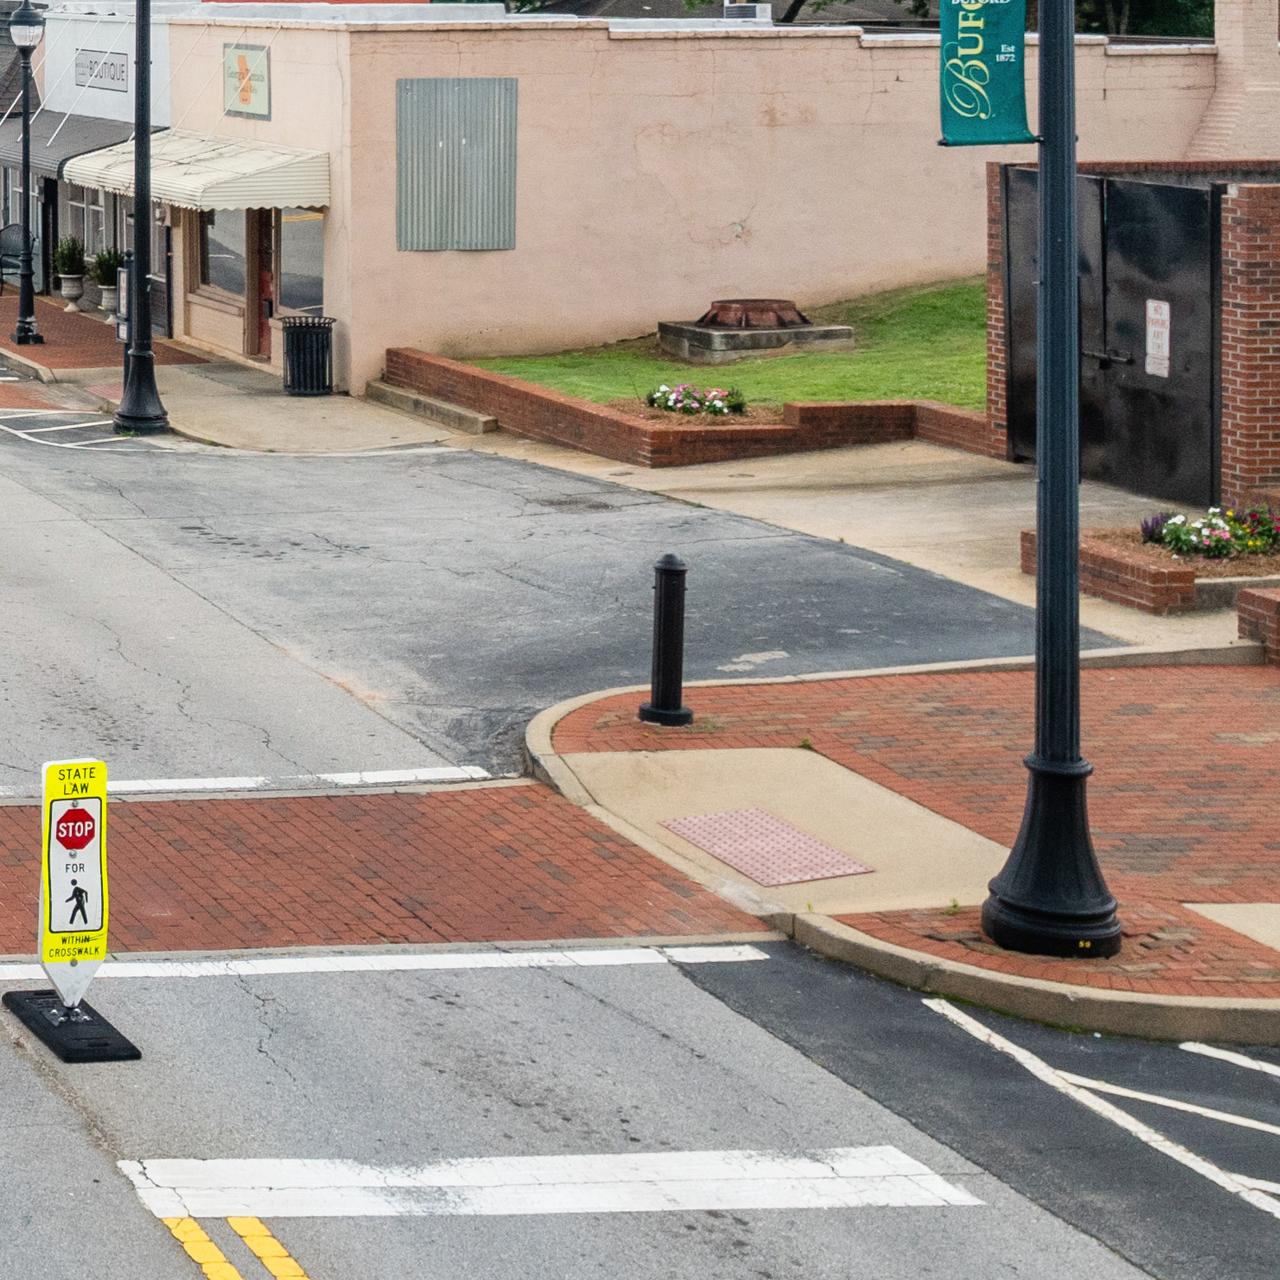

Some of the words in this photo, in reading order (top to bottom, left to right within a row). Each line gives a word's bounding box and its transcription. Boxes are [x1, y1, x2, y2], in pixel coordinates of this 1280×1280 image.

[89, 60, 125, 81] BOUTIQUE
[58, 767, 96, 781] STATE
[63, 783, 89, 796] LAW
[58, 820, 93, 838] STOP
[65, 863, 85, 873] FOR
[61, 935, 90, 945] WITHIN
[48, 946, 100, 958] CROSSWALK
